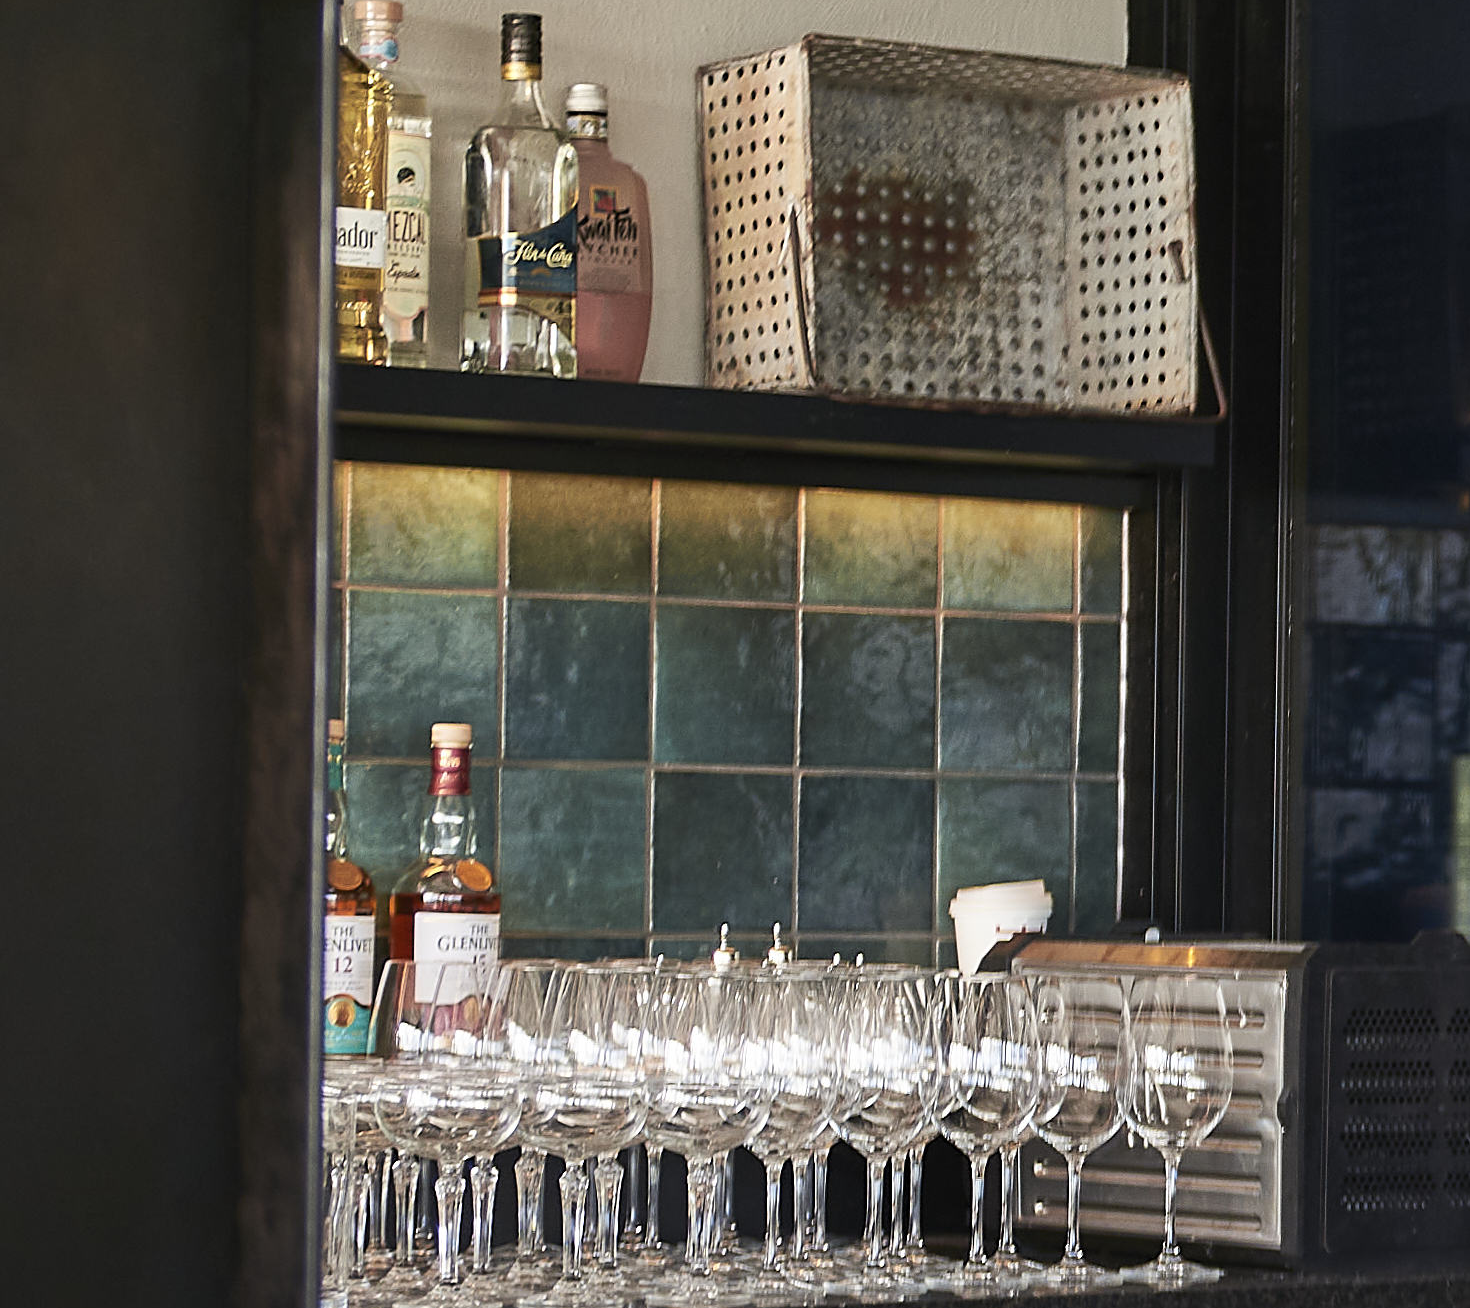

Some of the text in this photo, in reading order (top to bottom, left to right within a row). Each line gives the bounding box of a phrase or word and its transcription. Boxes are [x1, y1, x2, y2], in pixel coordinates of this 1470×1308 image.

[337, 220, 378, 249] ador
[576, 244, 638, 259] YCHEE
[332, 925, 354, 937] THE
[470, 923, 489, 936] THE
[334, 955, 353, 974] 12
